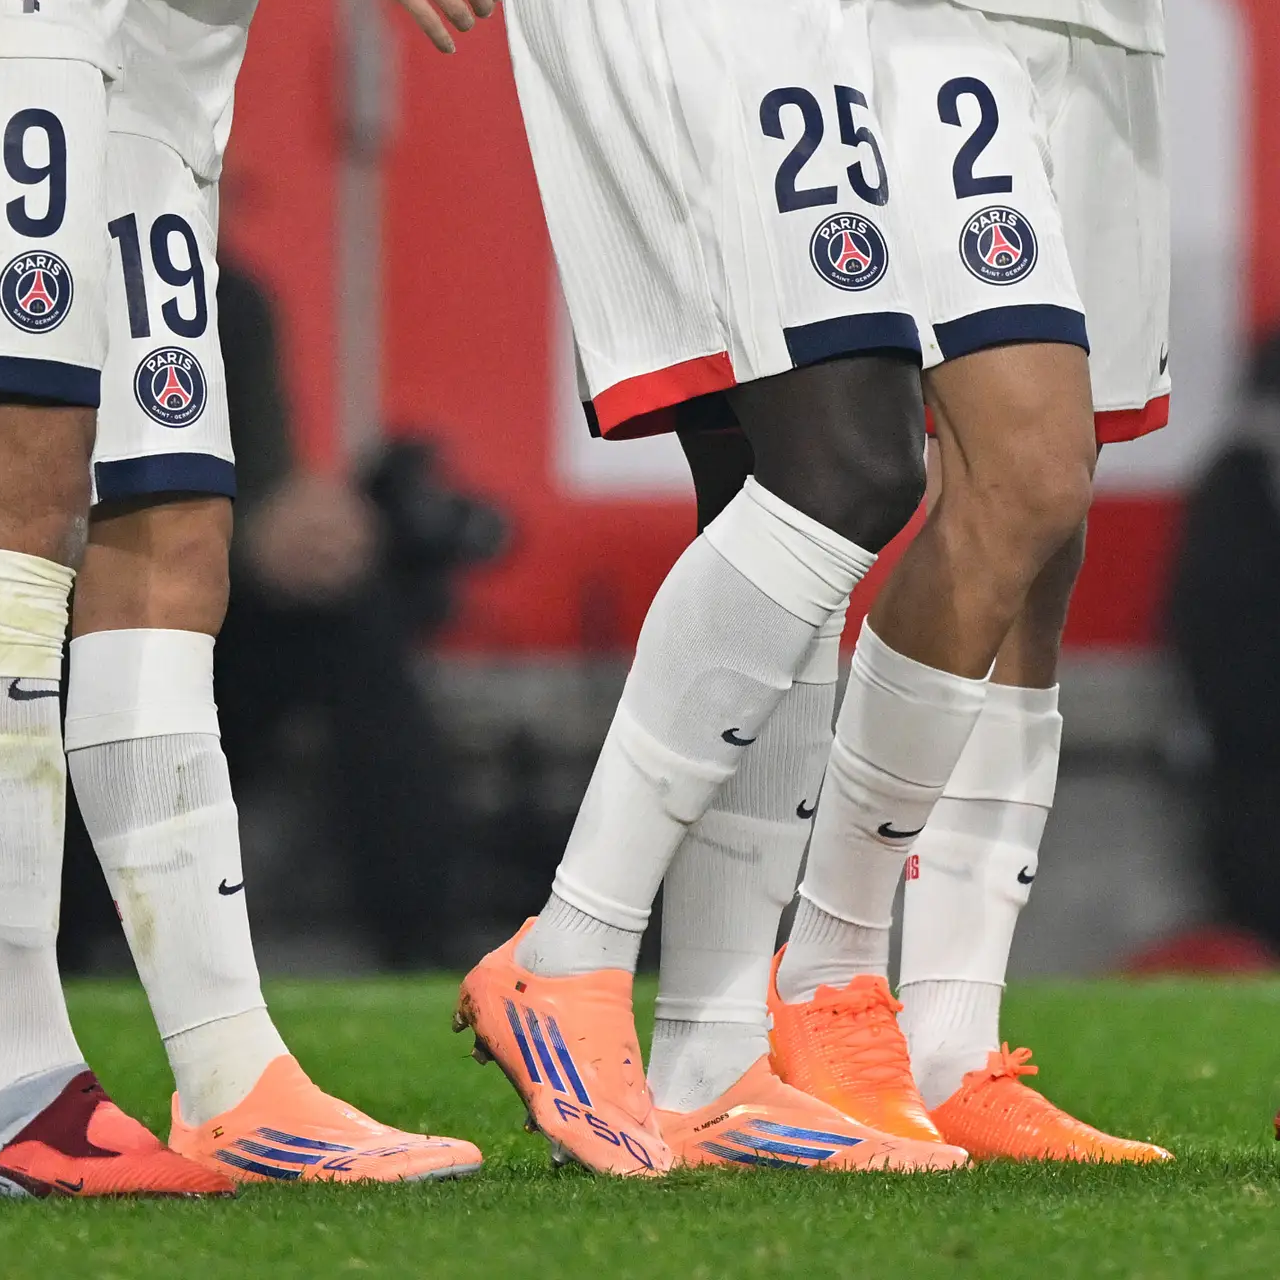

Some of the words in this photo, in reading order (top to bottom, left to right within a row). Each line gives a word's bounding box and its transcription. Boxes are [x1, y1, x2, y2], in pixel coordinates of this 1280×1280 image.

[3, 107, 67, 239] 9
[759, 84, 889, 214] 25
[937, 76, 1013, 200] 2
[820, 217, 868, 240] PARIS
[969, 210, 1018, 235] PARIS
[13, 256, 62, 276] PARIS
[107, 212, 208, 339] 19
[146, 352, 193, 373] PARIS
[553, 1097, 655, 1171] F50
